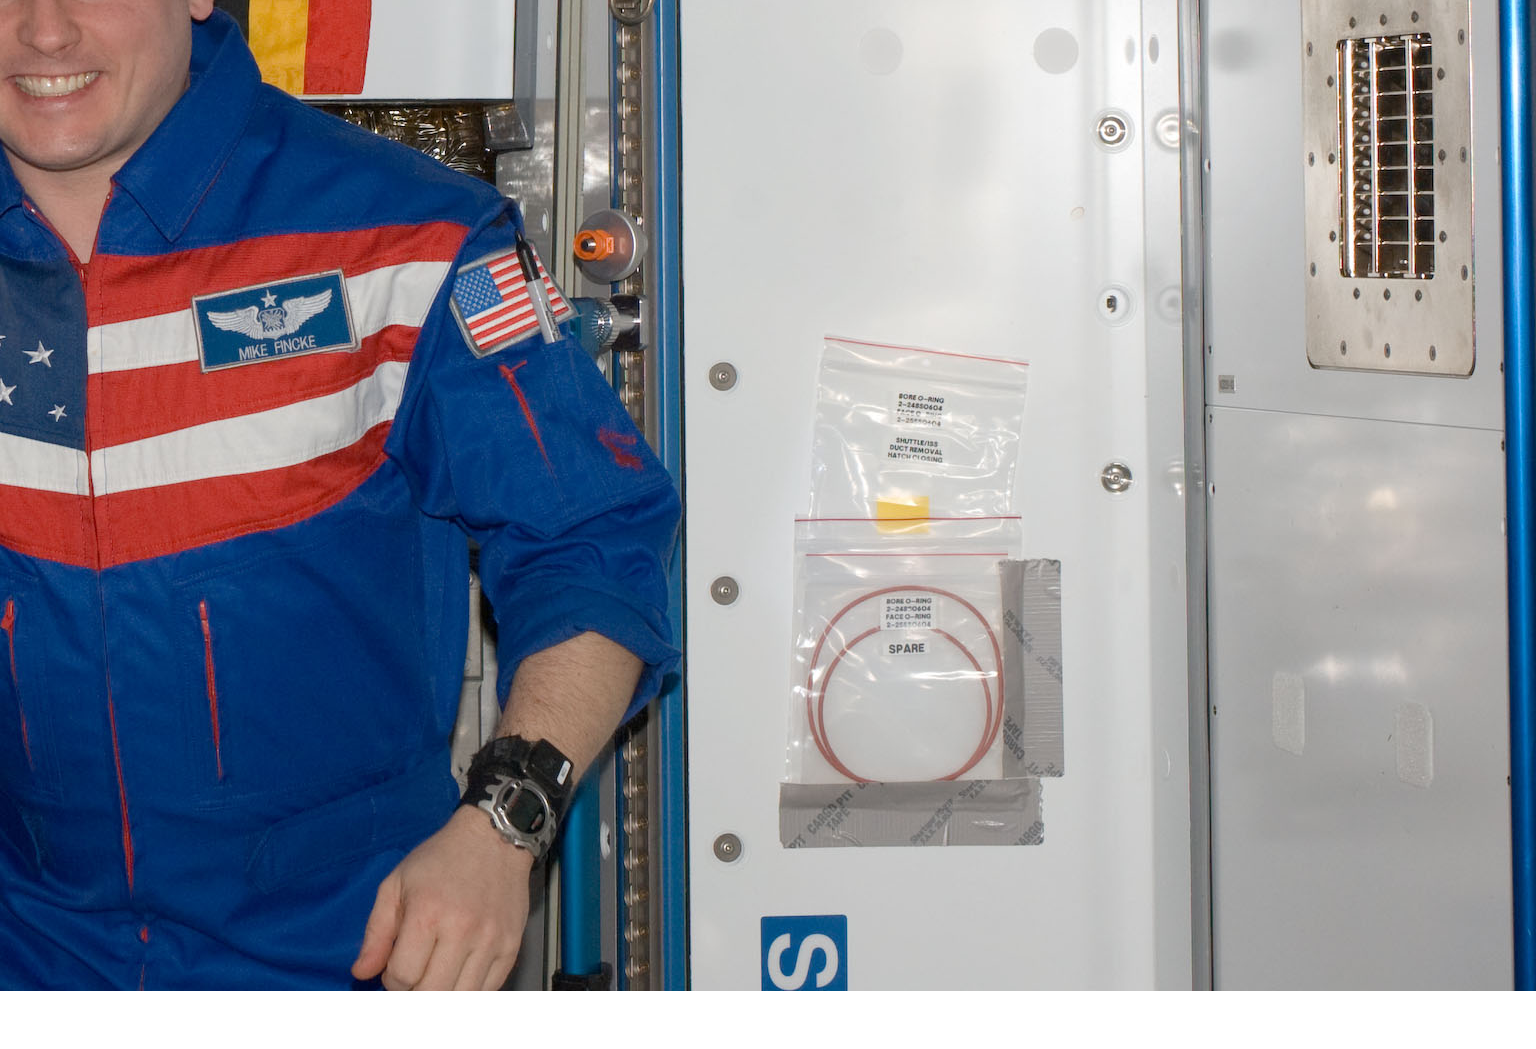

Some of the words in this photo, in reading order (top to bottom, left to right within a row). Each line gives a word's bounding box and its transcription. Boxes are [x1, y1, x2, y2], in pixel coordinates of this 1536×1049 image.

[238, 343, 269, 362] MIKE
[273, 334, 317, 355] FINCKE
[898, 393, 917, 401] BORE
[917, 395, 945, 404] O-RING
[895, 437, 938, 448] SHUTTLE/ISS
[889, 444, 908, 452] DUCT
[909, 446, 943, 456] REMOVAL
[887, 452, 911, 460] HATCH
[912, 454, 943, 463] CLOSING
[888, 643, 926, 654] SPARE
[1004, 715, 1023, 741] TAPE
[807, 803, 838, 835] CARGO
[836, 790, 854, 807] PIT
[826, 806, 851, 832] TAPE
